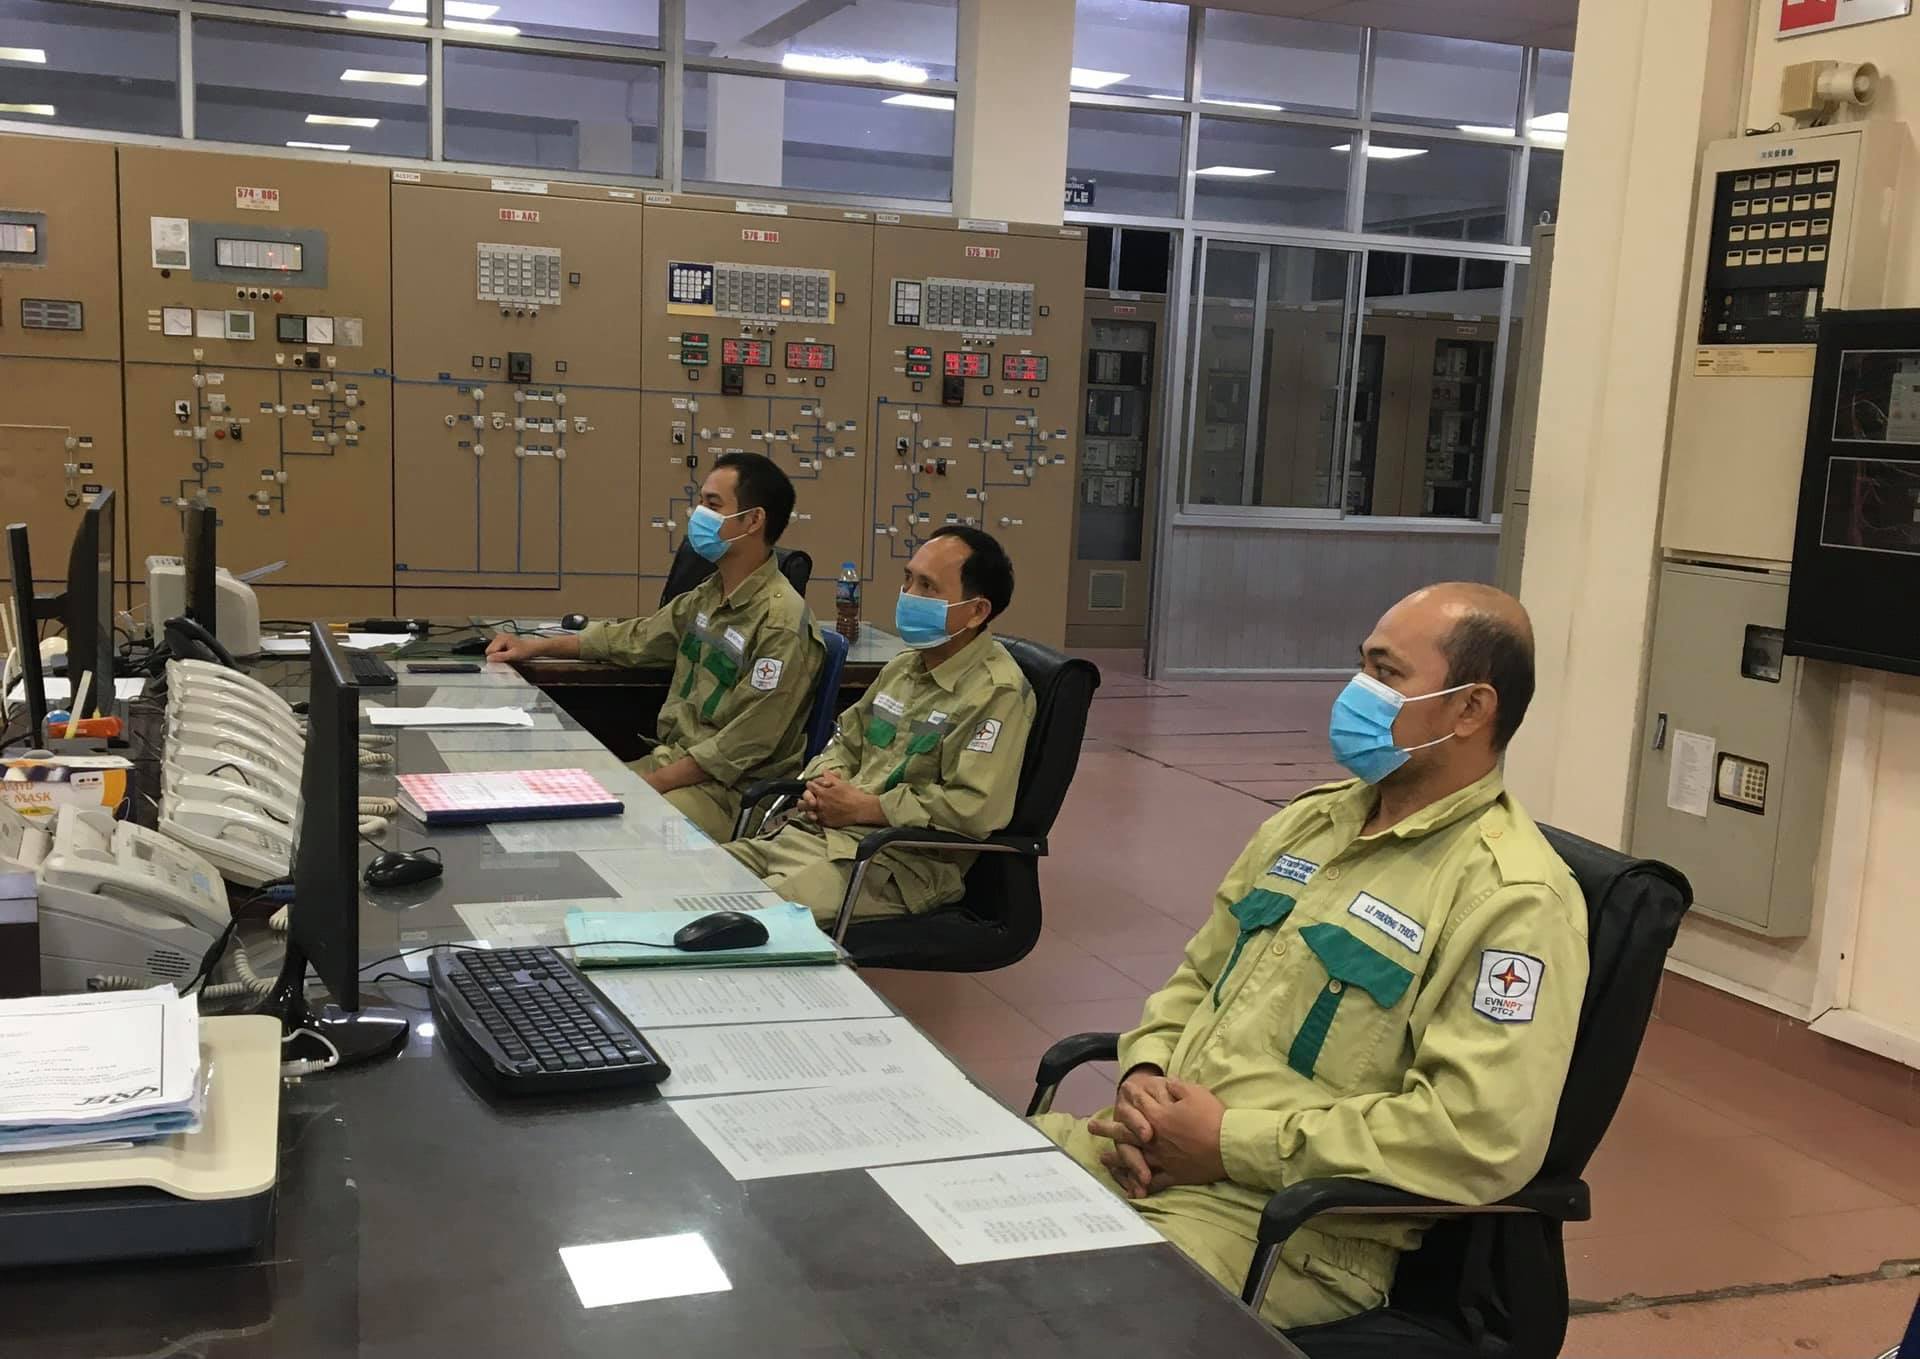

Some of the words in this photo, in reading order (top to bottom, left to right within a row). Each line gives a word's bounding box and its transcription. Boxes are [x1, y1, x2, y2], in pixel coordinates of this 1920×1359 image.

[15, 791, 52, 803] MASK
[1485, 997, 1522, 1011] EVNNPT
[1490, 1007, 1514, 1016] PTC2
